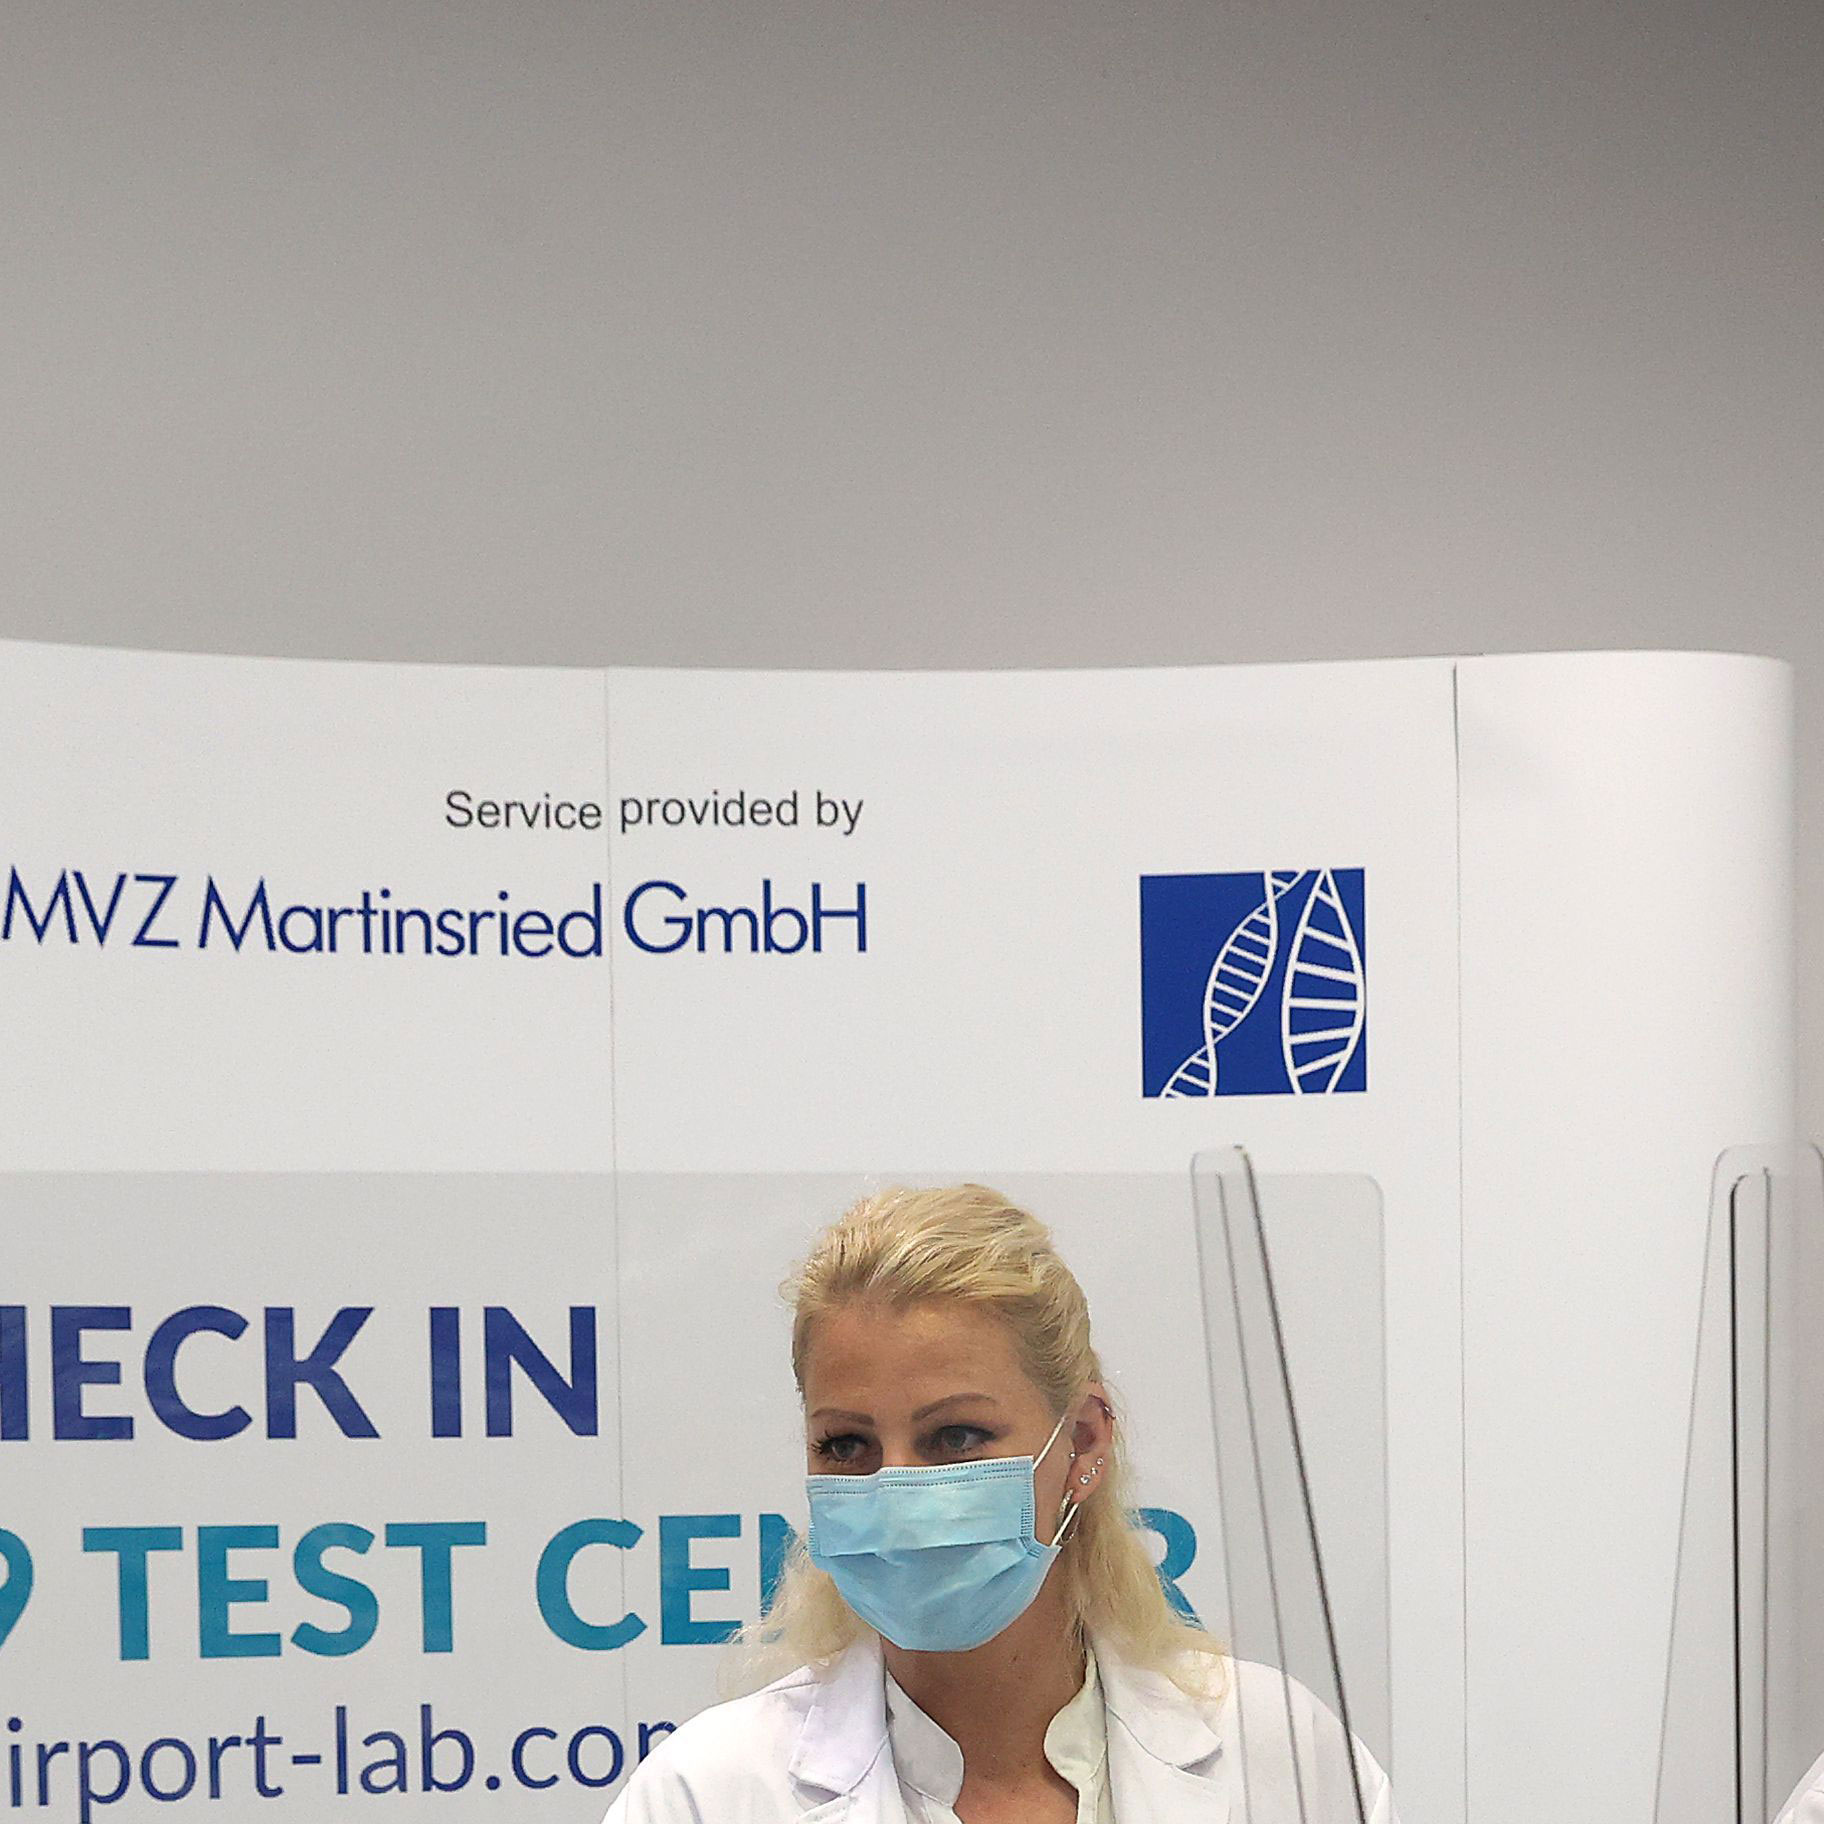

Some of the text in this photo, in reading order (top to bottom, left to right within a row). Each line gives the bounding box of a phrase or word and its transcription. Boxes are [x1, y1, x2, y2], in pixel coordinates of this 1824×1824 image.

[446, 789, 864, 837] Service provided by
[0, 864, 868, 959] MVZ Martinsried GmbH
[428, 1306, 599, 1439] IN
[82, 1520, 488, 1662] TEST
